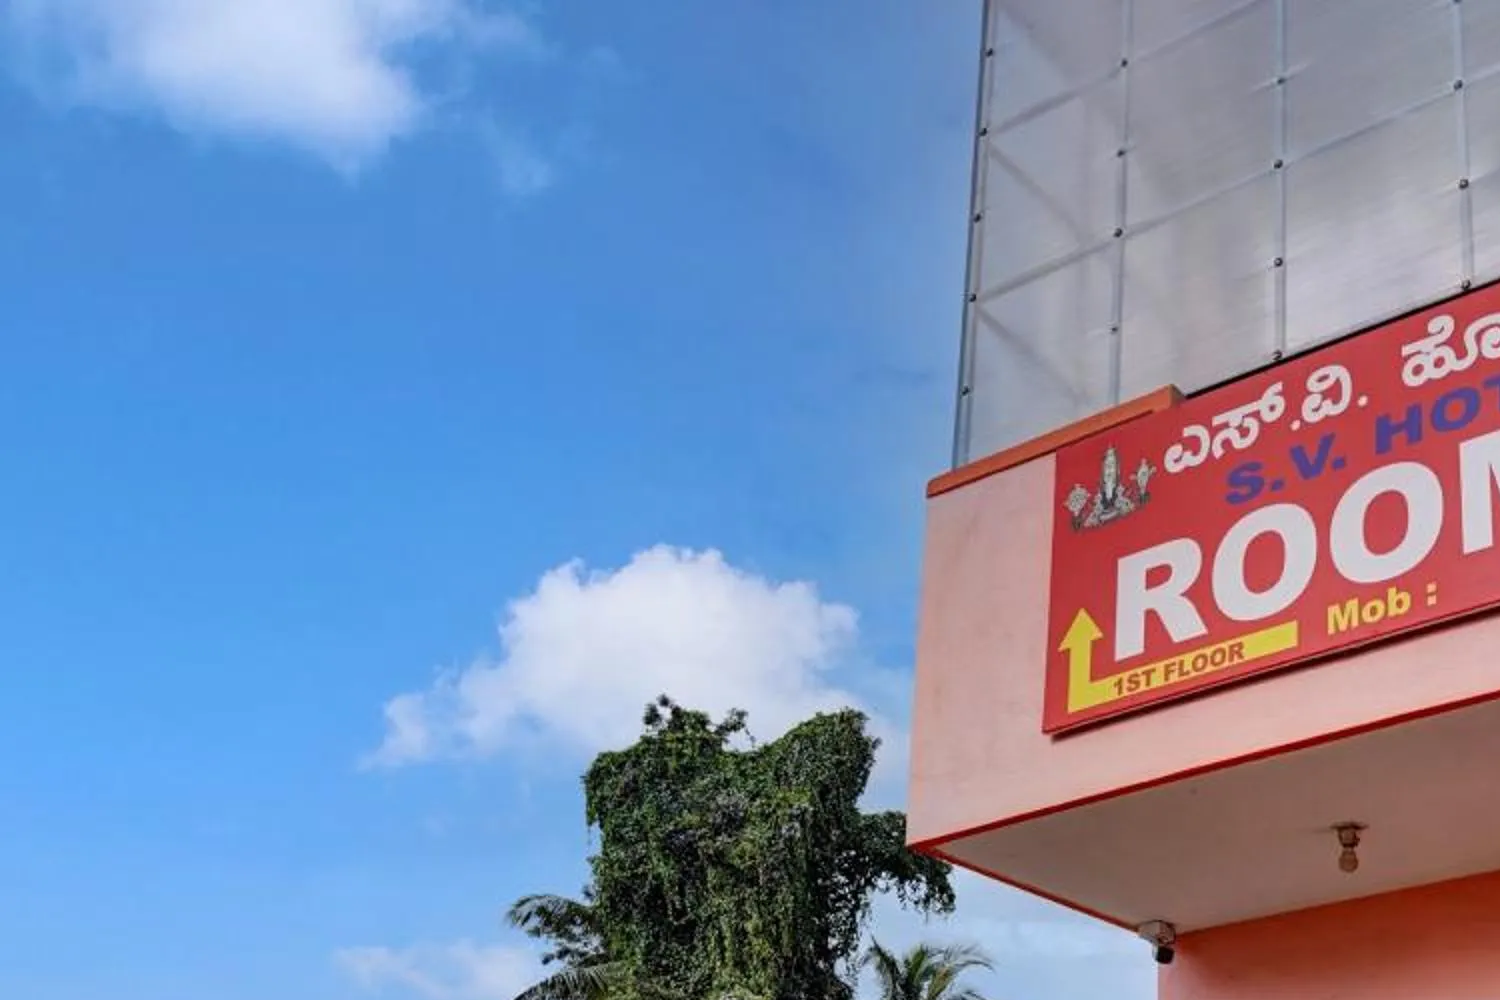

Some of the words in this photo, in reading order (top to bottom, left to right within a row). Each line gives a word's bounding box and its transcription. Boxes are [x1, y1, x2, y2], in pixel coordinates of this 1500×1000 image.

[1327, 586, 1412, 635] Mob
[1113, 671, 1156, 697] 1ST
[1163, 641, 1245, 682] FLOOR
